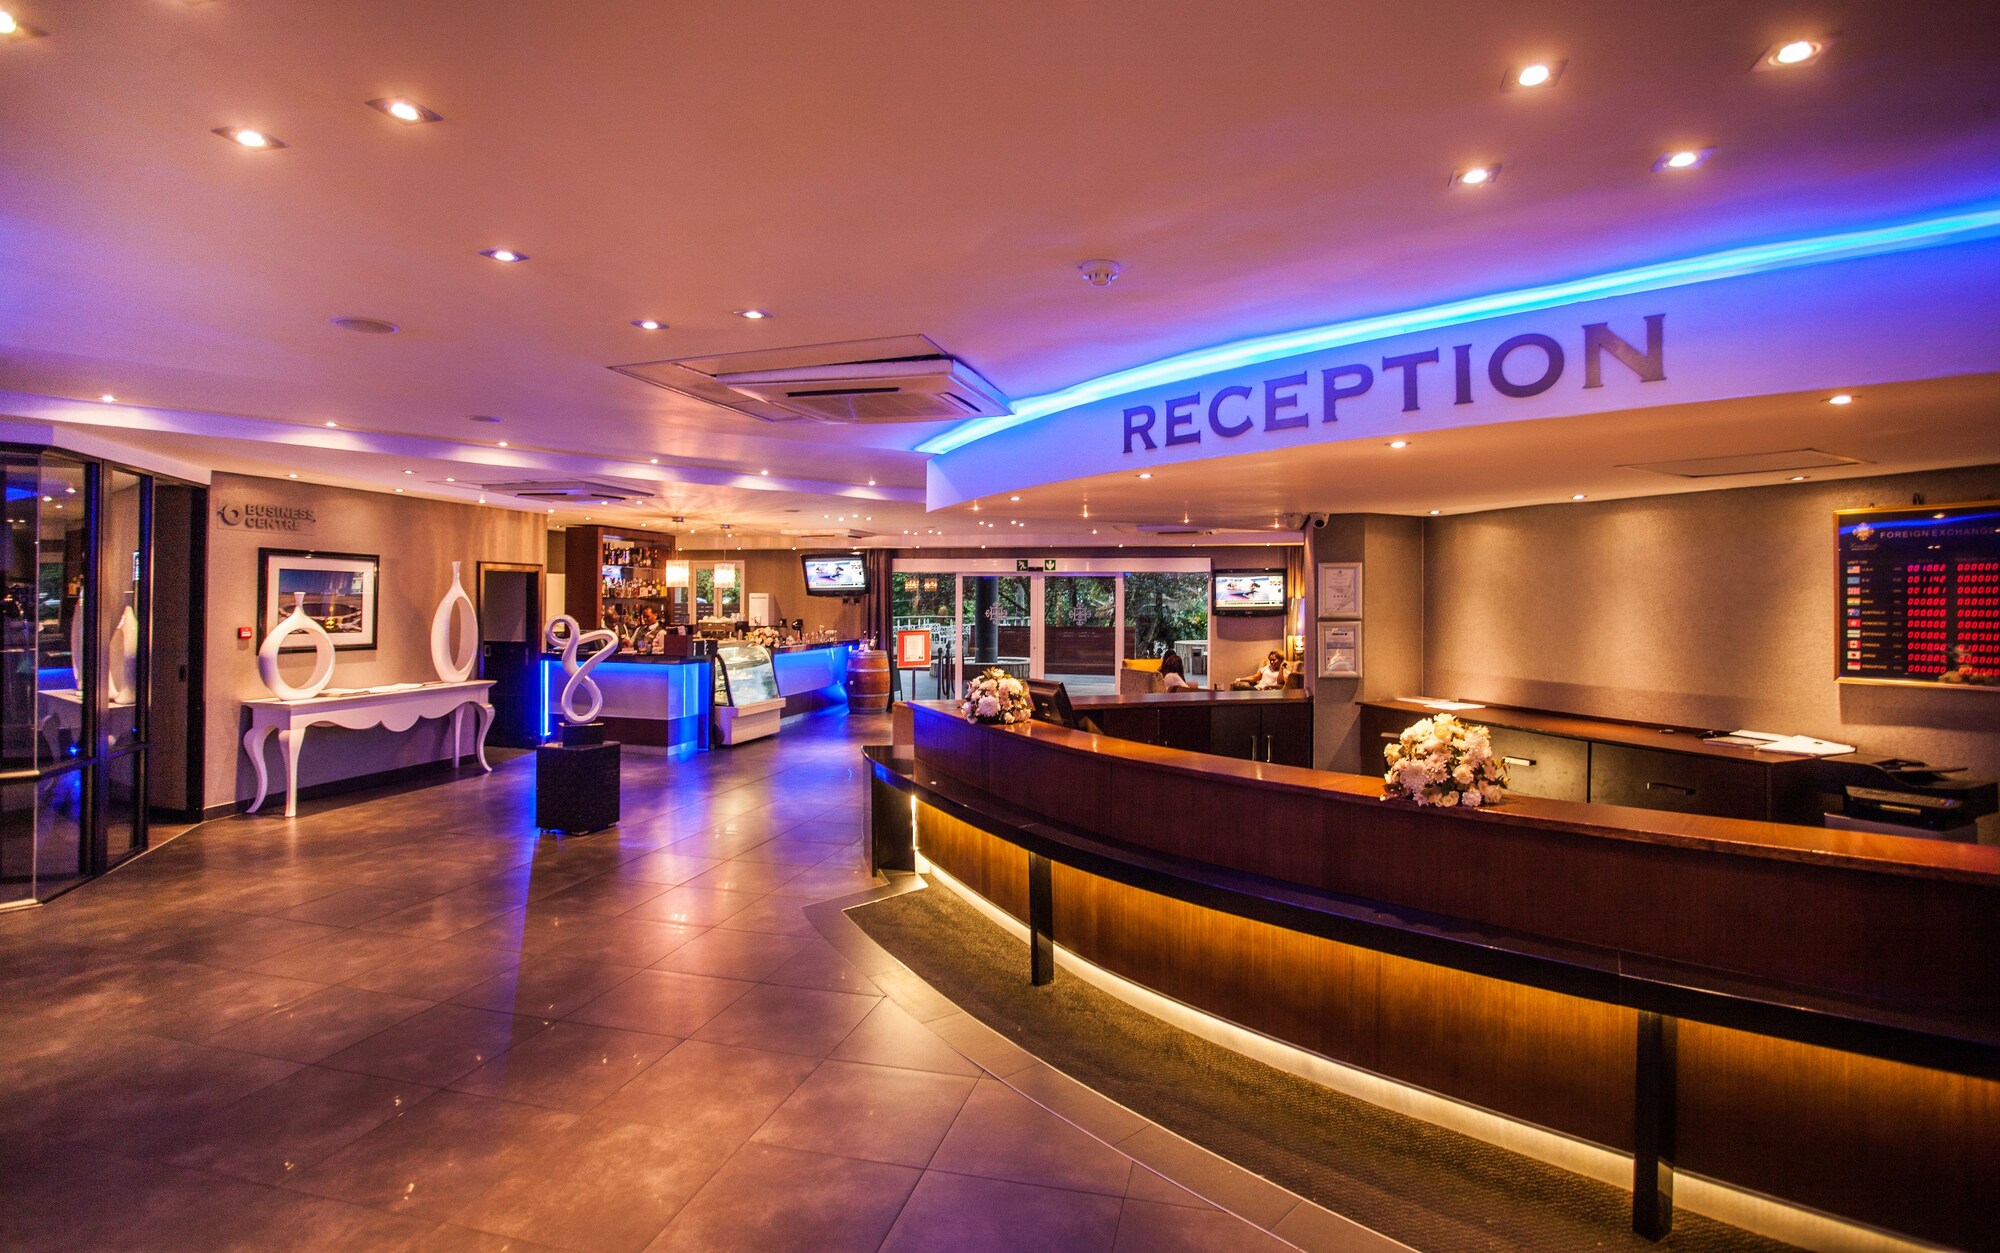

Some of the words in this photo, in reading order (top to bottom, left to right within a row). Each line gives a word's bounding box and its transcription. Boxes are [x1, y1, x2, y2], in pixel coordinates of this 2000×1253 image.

[1122, 313, 1667, 453] RECEPTION
[244, 504, 314, 521] BUSINESS
[244, 518, 302, 531] CENTRE
[1879, 530, 1929, 539] FOREIGN
[1931, 527, 1996, 537] EXCHANGE
